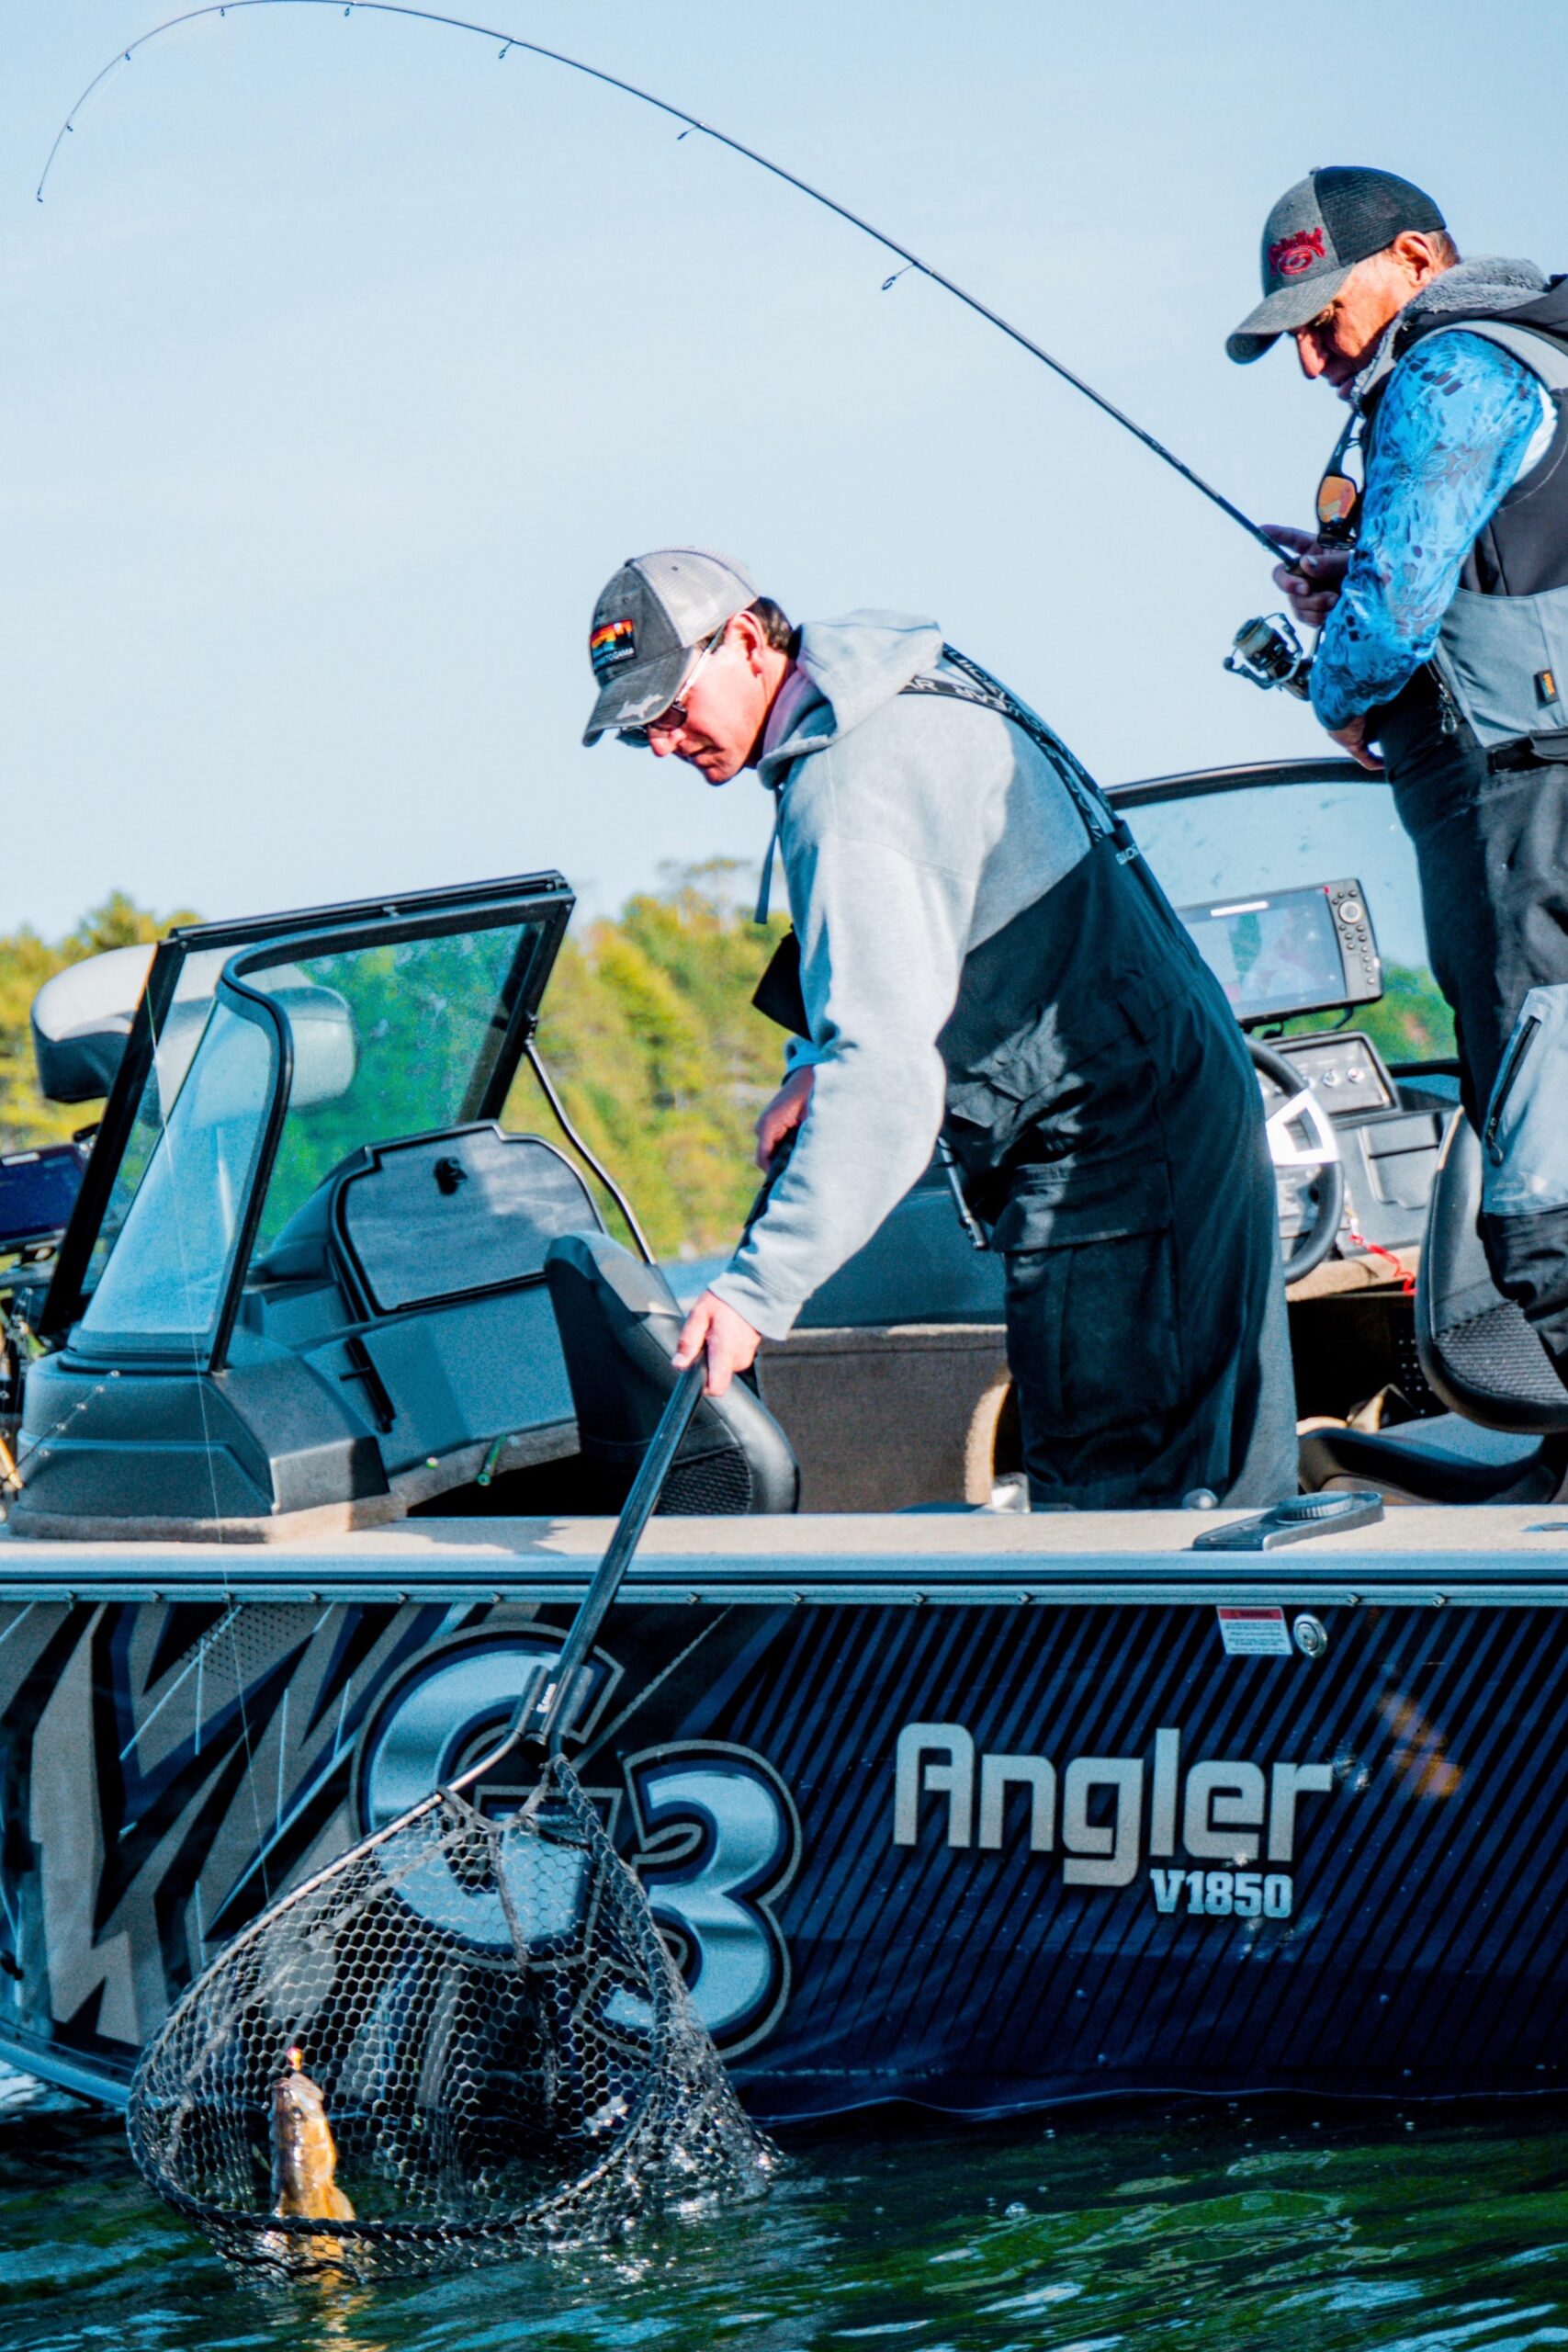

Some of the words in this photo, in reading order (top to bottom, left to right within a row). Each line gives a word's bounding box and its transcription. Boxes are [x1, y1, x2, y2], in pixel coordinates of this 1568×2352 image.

[359, 1632, 795, 2051] G3
[893, 1722, 1334, 1887] Angler
[1149, 1868, 1293, 1918] V1850
